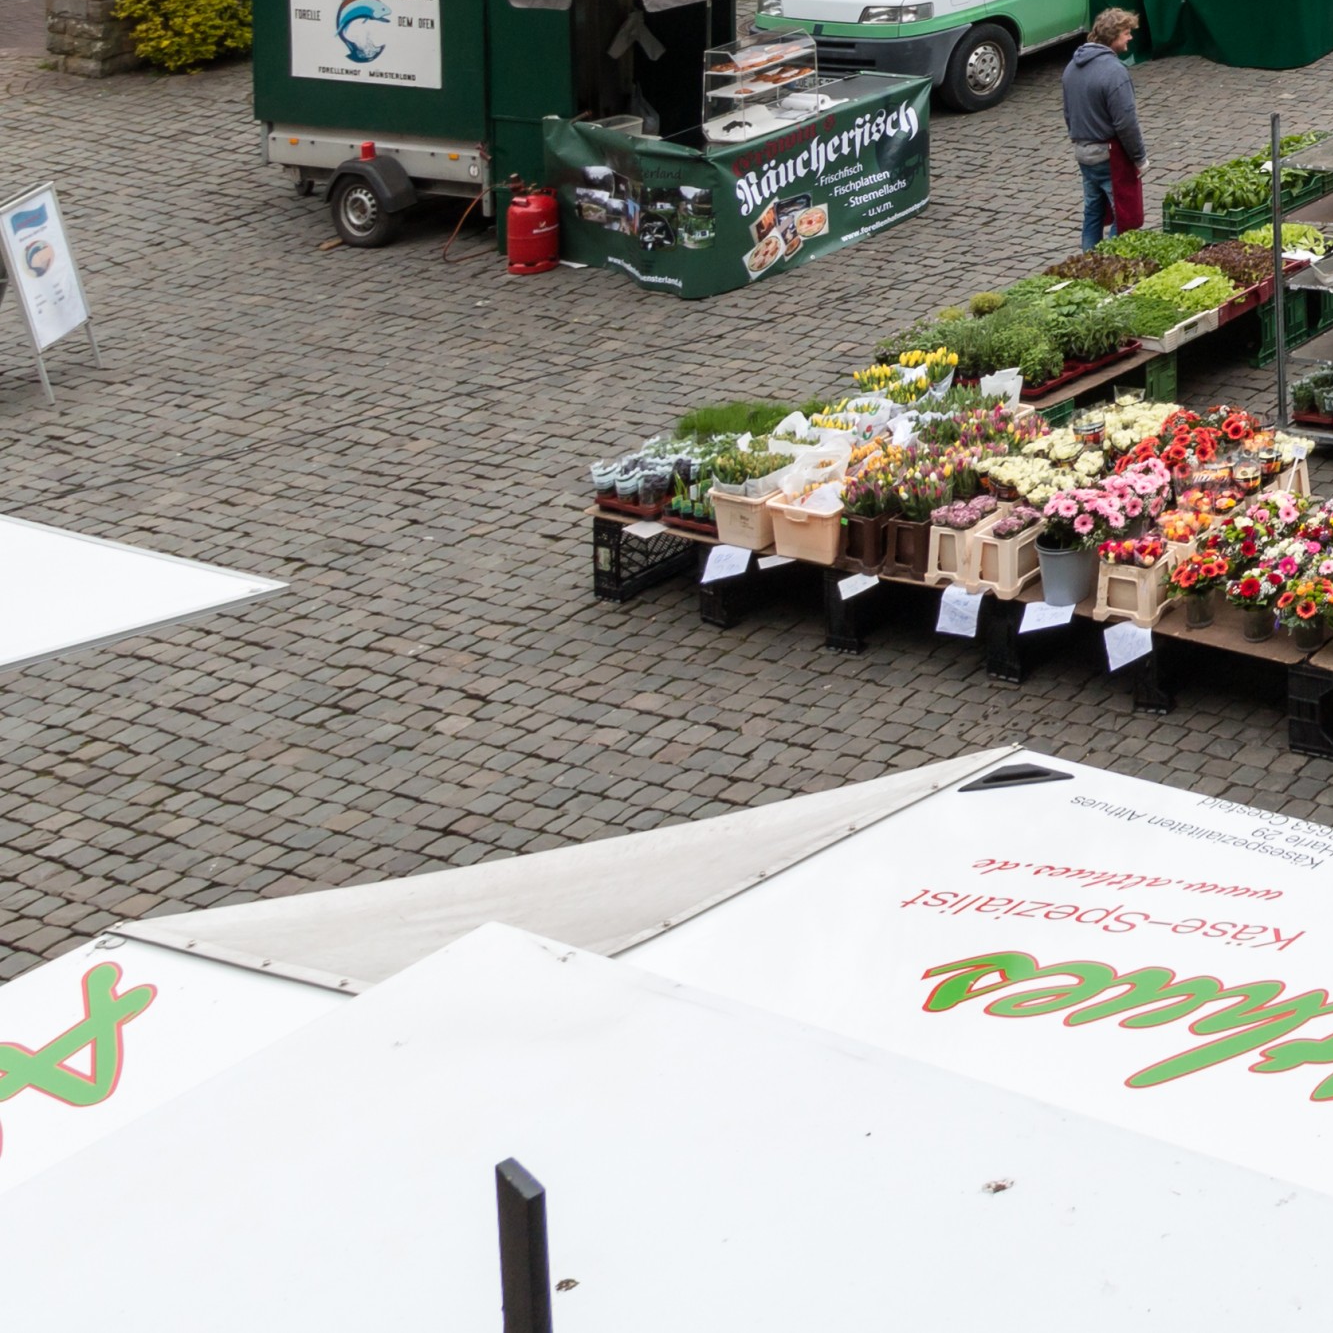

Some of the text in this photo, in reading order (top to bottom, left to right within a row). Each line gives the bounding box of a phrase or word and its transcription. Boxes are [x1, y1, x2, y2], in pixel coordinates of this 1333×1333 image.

[736, 99, 919, 217] Räucherfisch
[819, 162, 863, 188] Frischfisch
[833, 170, 891, 198] Fischplatten
[848, 178, 907, 209] Stremellachs
[868, 200, 895, 218] u.v.m.
[1196, 796, 1292, 828] Coesfeld
[1070, 794, 1325, 870] Käsespezialitäten Althues
[1251, 826, 1283, 844] 29
[971, 857, 1284, 902] www.althues.de
[901, 888, 1306, 951] Käse-Spezialist
